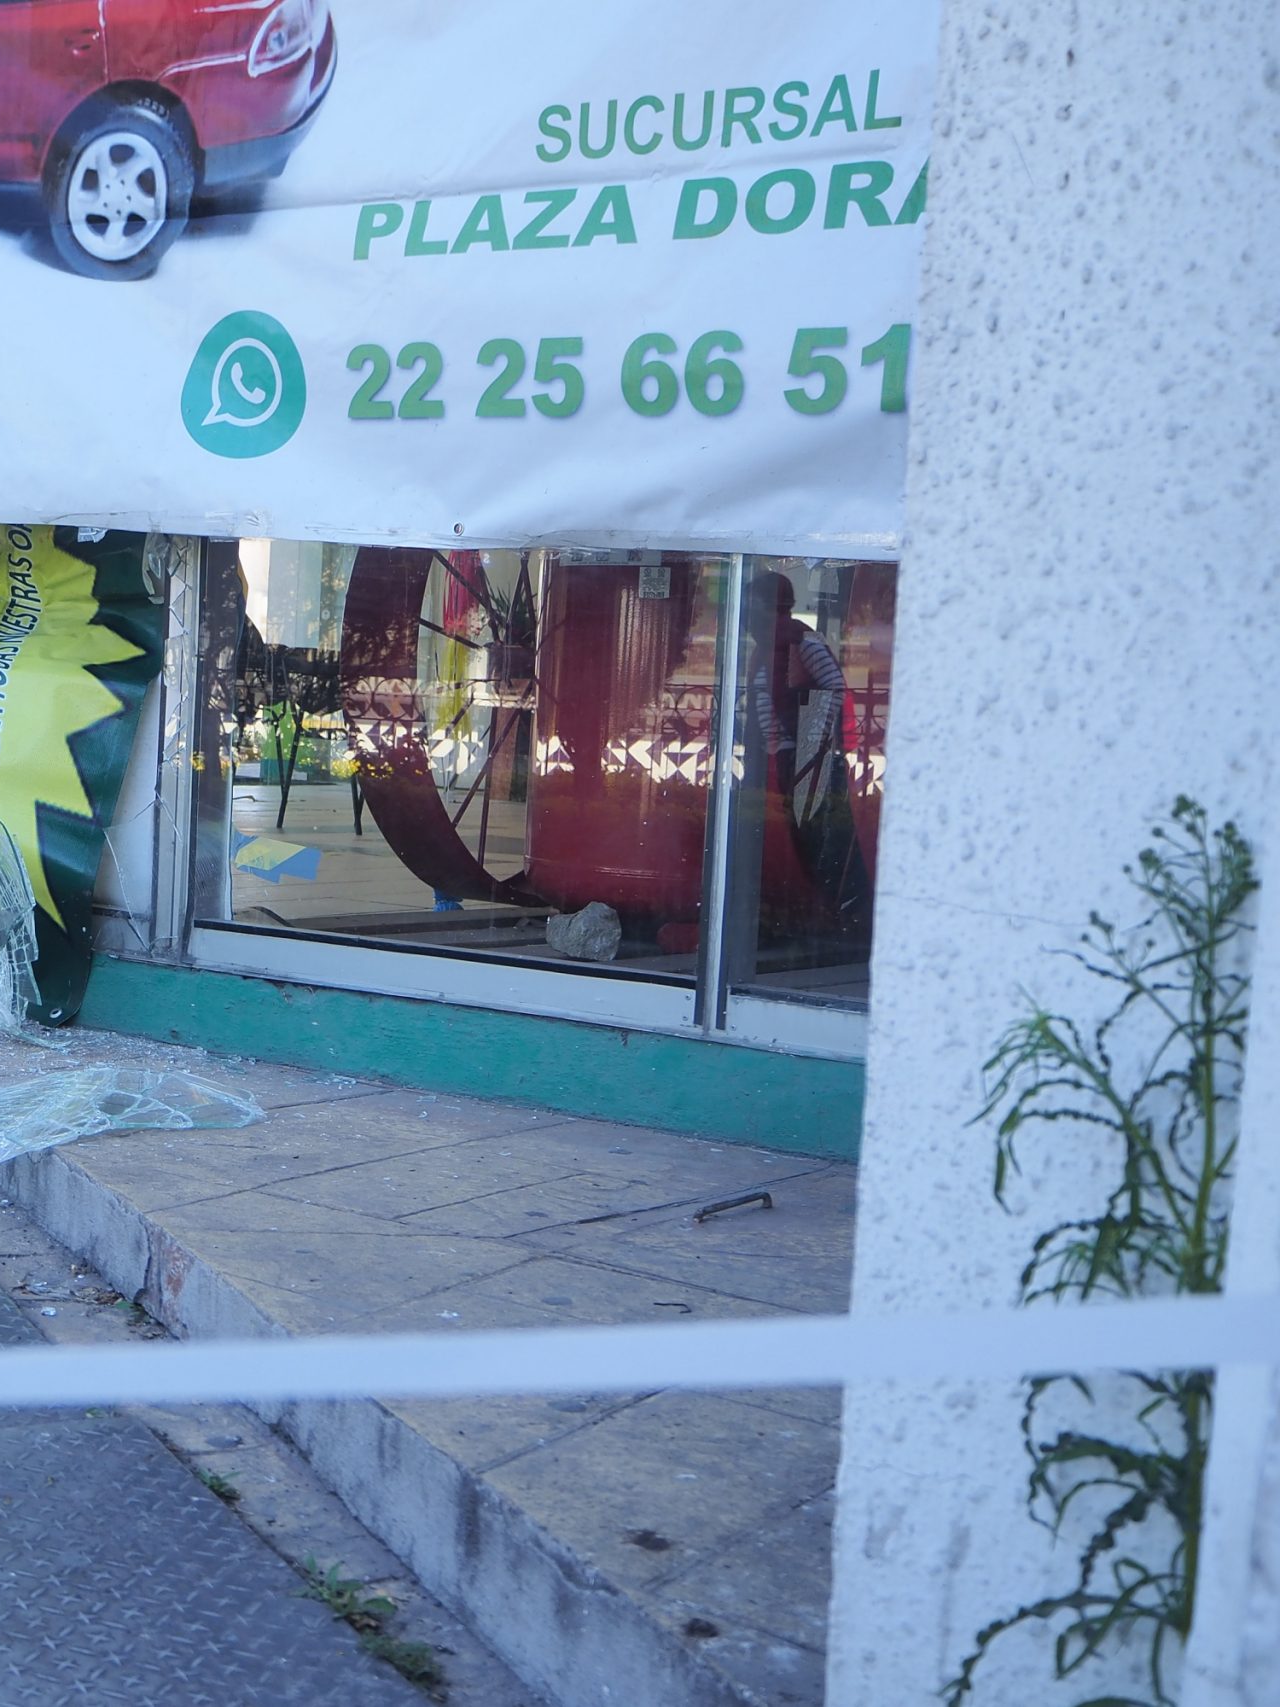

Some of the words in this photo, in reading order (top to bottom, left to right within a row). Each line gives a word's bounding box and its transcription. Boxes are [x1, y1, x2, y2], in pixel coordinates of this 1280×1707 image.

[535, 69, 903, 162] SUCURSAL
[352, 184, 638, 261] PLAZA
[346, 342, 446, 420] 22
[475, 336, 585, 420] 25
[620, 330, 746, 418] 66
[783, 323, 912, 416] 51
